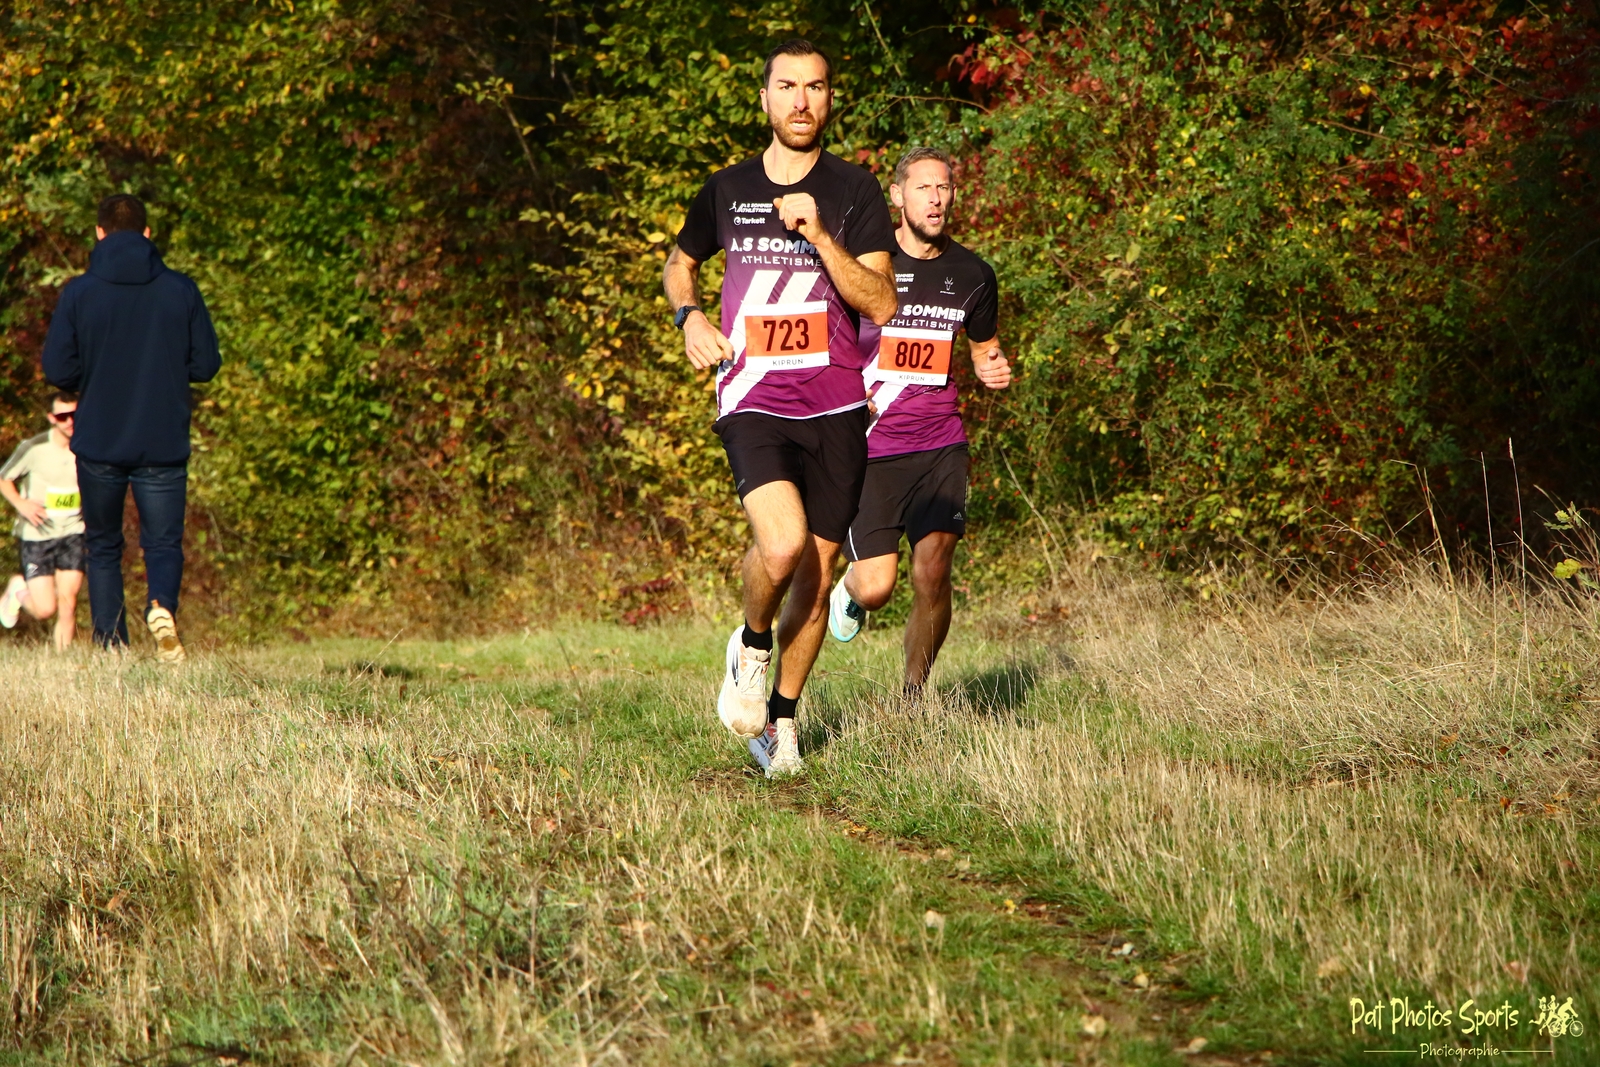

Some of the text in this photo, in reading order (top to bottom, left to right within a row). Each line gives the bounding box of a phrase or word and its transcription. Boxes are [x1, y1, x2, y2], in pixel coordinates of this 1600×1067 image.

[741, 217, 766, 225] Tarkett
[730, 237, 820, 254] A.S SOMM
[741, 255, 822, 267] ATHLETISME
[902, 304, 966, 322] SOMMER
[887, 318, 955, 331] THLETISME
[763, 318, 810, 352] 723
[895, 341, 935, 370] 802
[772, 358, 804, 367] KIPRUN
[898, 374, 926, 382] KIPRUN
